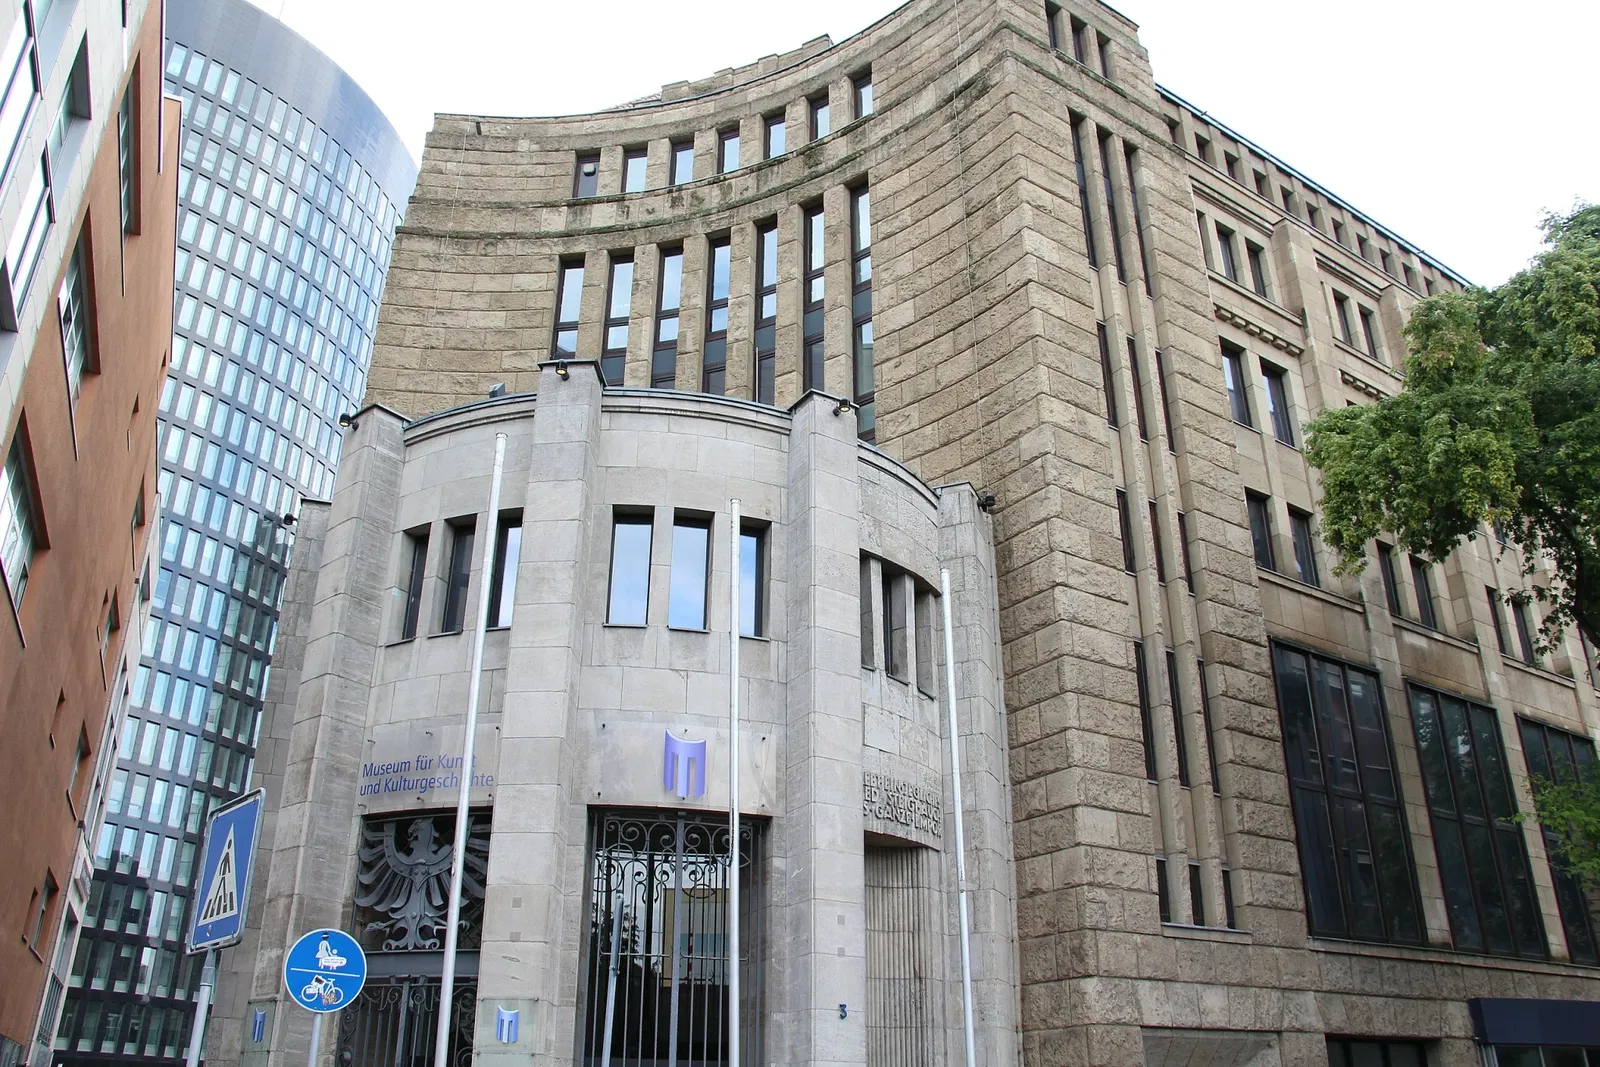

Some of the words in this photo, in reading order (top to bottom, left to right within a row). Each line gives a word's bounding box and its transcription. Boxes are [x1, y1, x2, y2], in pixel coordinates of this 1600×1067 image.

[363, 760, 411, 778] Museum
[415, 754, 434, 771] für
[438, 754, 477, 769] Kunt
[360, 779, 381, 796] und
[384, 772, 494, 793] Kulturgeschhte
[839, 1003, 848, 1020] 3
